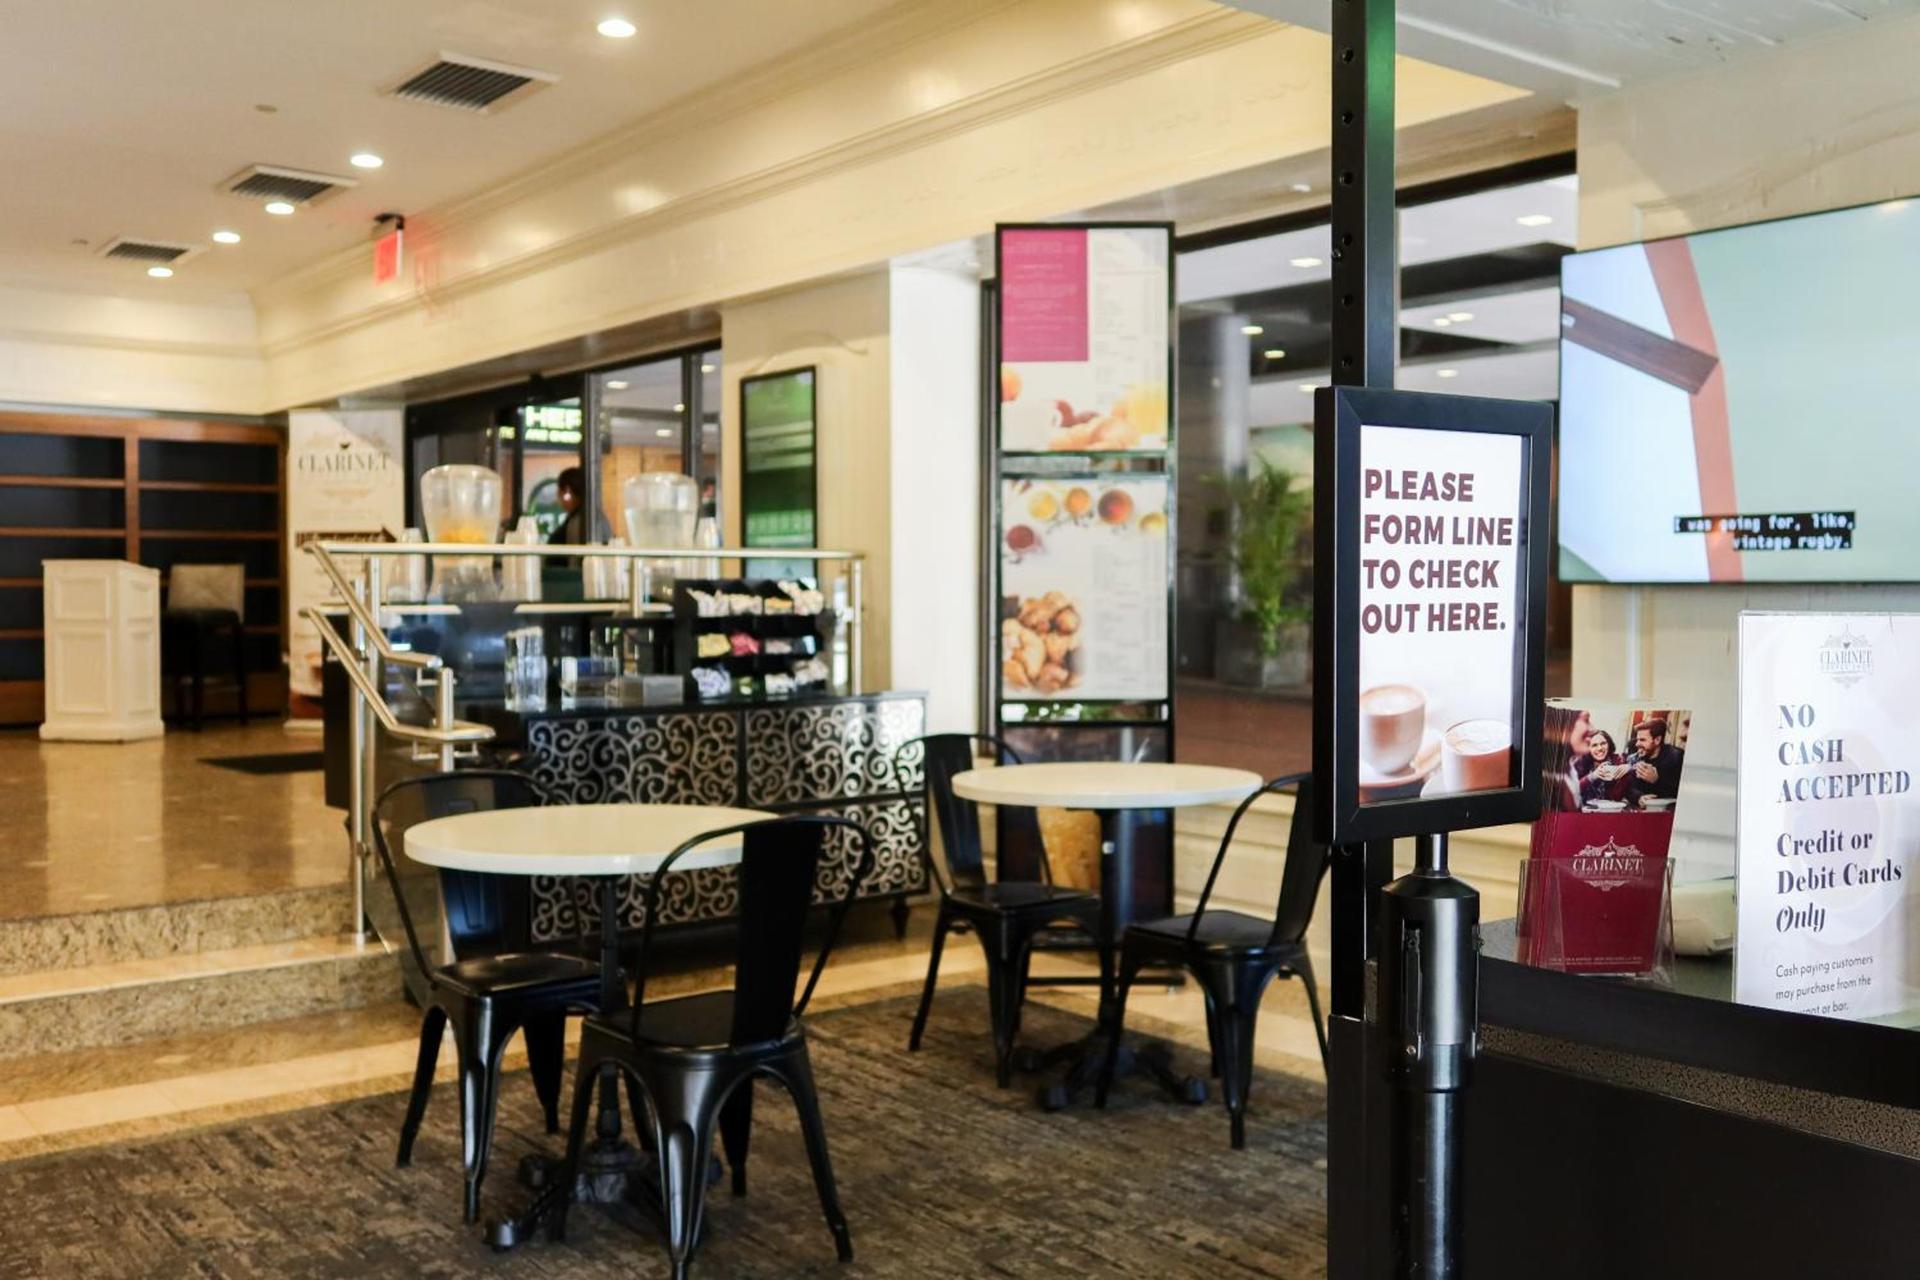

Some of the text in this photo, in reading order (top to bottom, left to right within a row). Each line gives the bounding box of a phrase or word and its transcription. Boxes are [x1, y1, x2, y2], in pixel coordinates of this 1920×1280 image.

[298, 451, 391, 472] CLARINET
[1364, 469, 1474, 502] PLEASE
[1364, 514, 1513, 546] FORM LINE
[1719, 516, 1760, 533] going
[1733, 533, 1850, 550] vintage rugby.
[1363, 559, 1500, 589] TO CHECK
[1362, 602, 1506, 634] OUT HERE.
[1820, 648, 1872, 664] CLARINET
[1778, 704, 1815, 729] NO
[1777, 738, 1844, 766] CASH
[1776, 770, 1911, 803] ACCEPTED
[1776, 829, 1873, 857] Credit or
[1572, 857, 1643, 872] CLARINET
[1776, 858, 1902, 894] Debit Cards
[1776, 902, 1826, 933] Only
[1776, 955, 1874, 978] Cash paying customers
[1776, 974, 1872, 1001] may purchase from the
[1822, 1004, 1831, 1015] or
